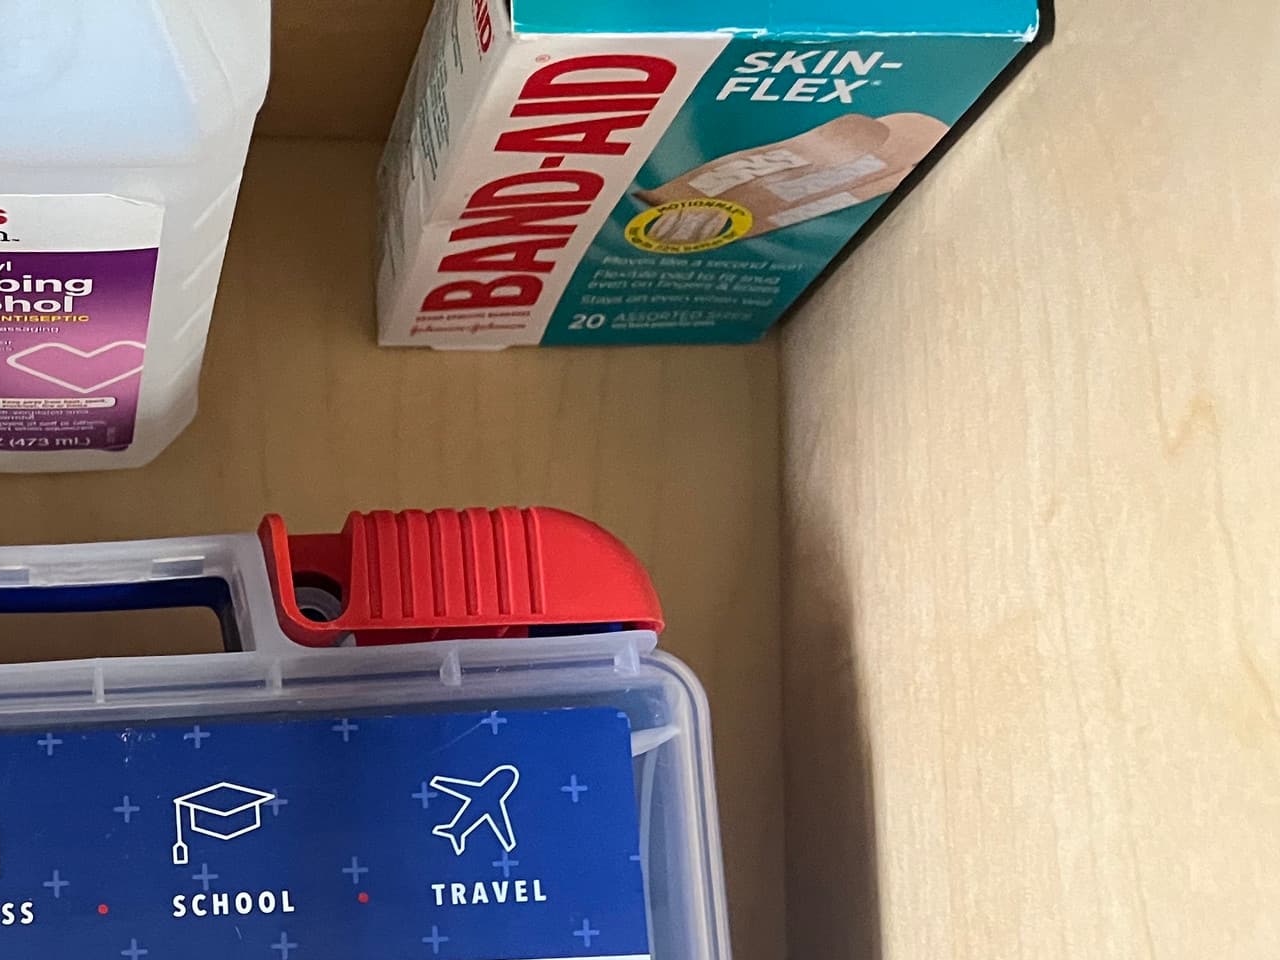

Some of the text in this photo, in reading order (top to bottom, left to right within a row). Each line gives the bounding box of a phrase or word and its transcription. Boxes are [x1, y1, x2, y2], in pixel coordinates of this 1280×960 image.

[734, 50, 903, 76] SKIN-
[716, 77, 869, 104] FLEX
[421, 54, 677, 312] BAND-AID
[568, 313, 605, 330] 20
[9, 436, 49, 447] (473
[173, 890, 295, 918] SCHOOL
[432, 879, 547, 907] TRAVEL
